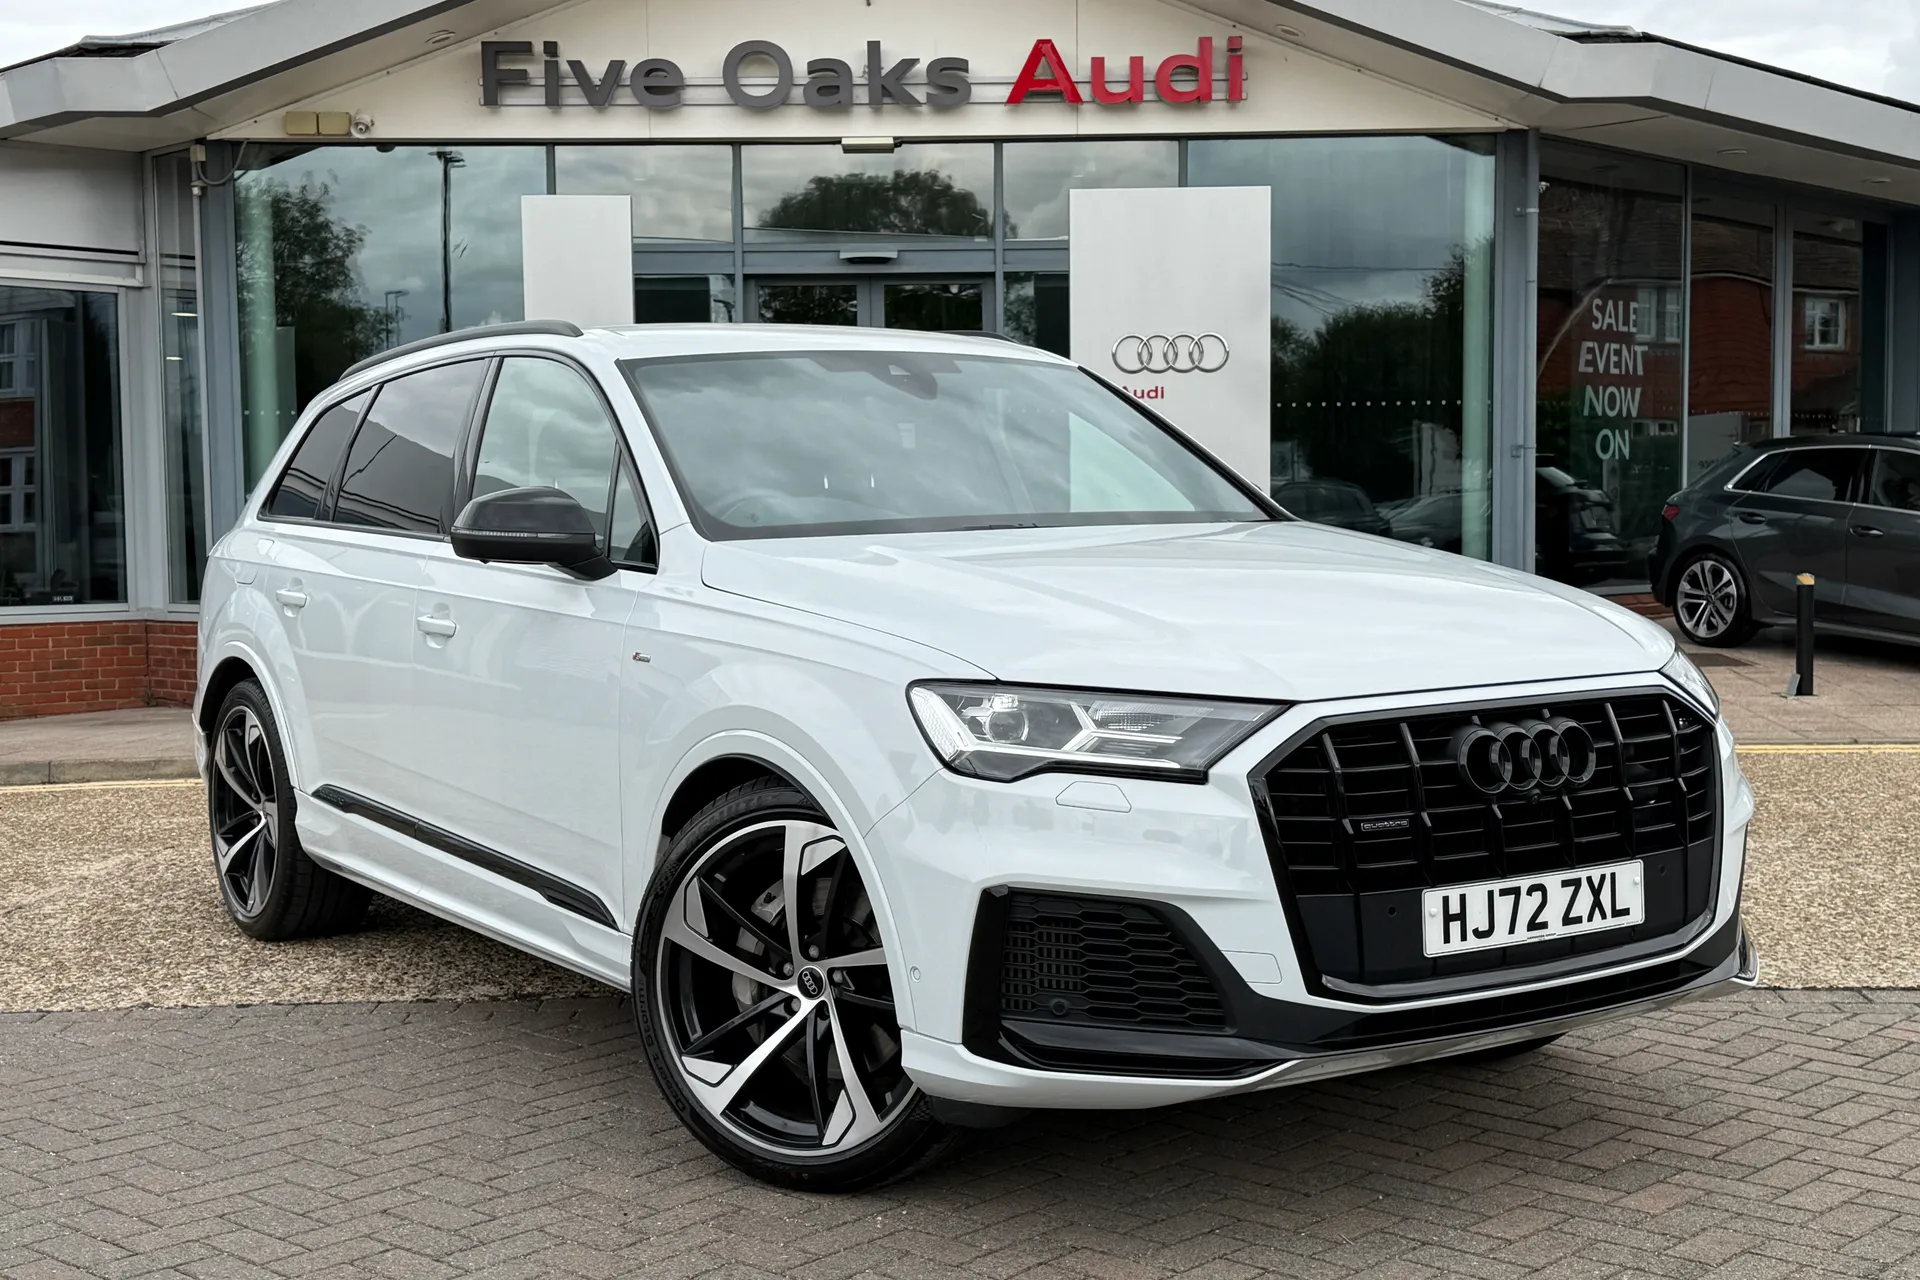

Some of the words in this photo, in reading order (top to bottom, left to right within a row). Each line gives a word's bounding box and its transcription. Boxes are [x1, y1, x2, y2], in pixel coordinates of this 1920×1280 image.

[481, 41, 685, 109] Five
[722, 40, 972, 108] Oaks
[1004, 36, 1243, 105] Audi
[1591, 298, 1638, 333] SALE
[1578, 341, 1649, 376] EVENT
[1122, 386, 1165, 399] udi
[1583, 385, 1642, 418] NOW
[1595, 428, 1630, 460] ON
[1442, 883, 1549, 945] HJ72
[1560, 872, 1631, 927] ZXL
